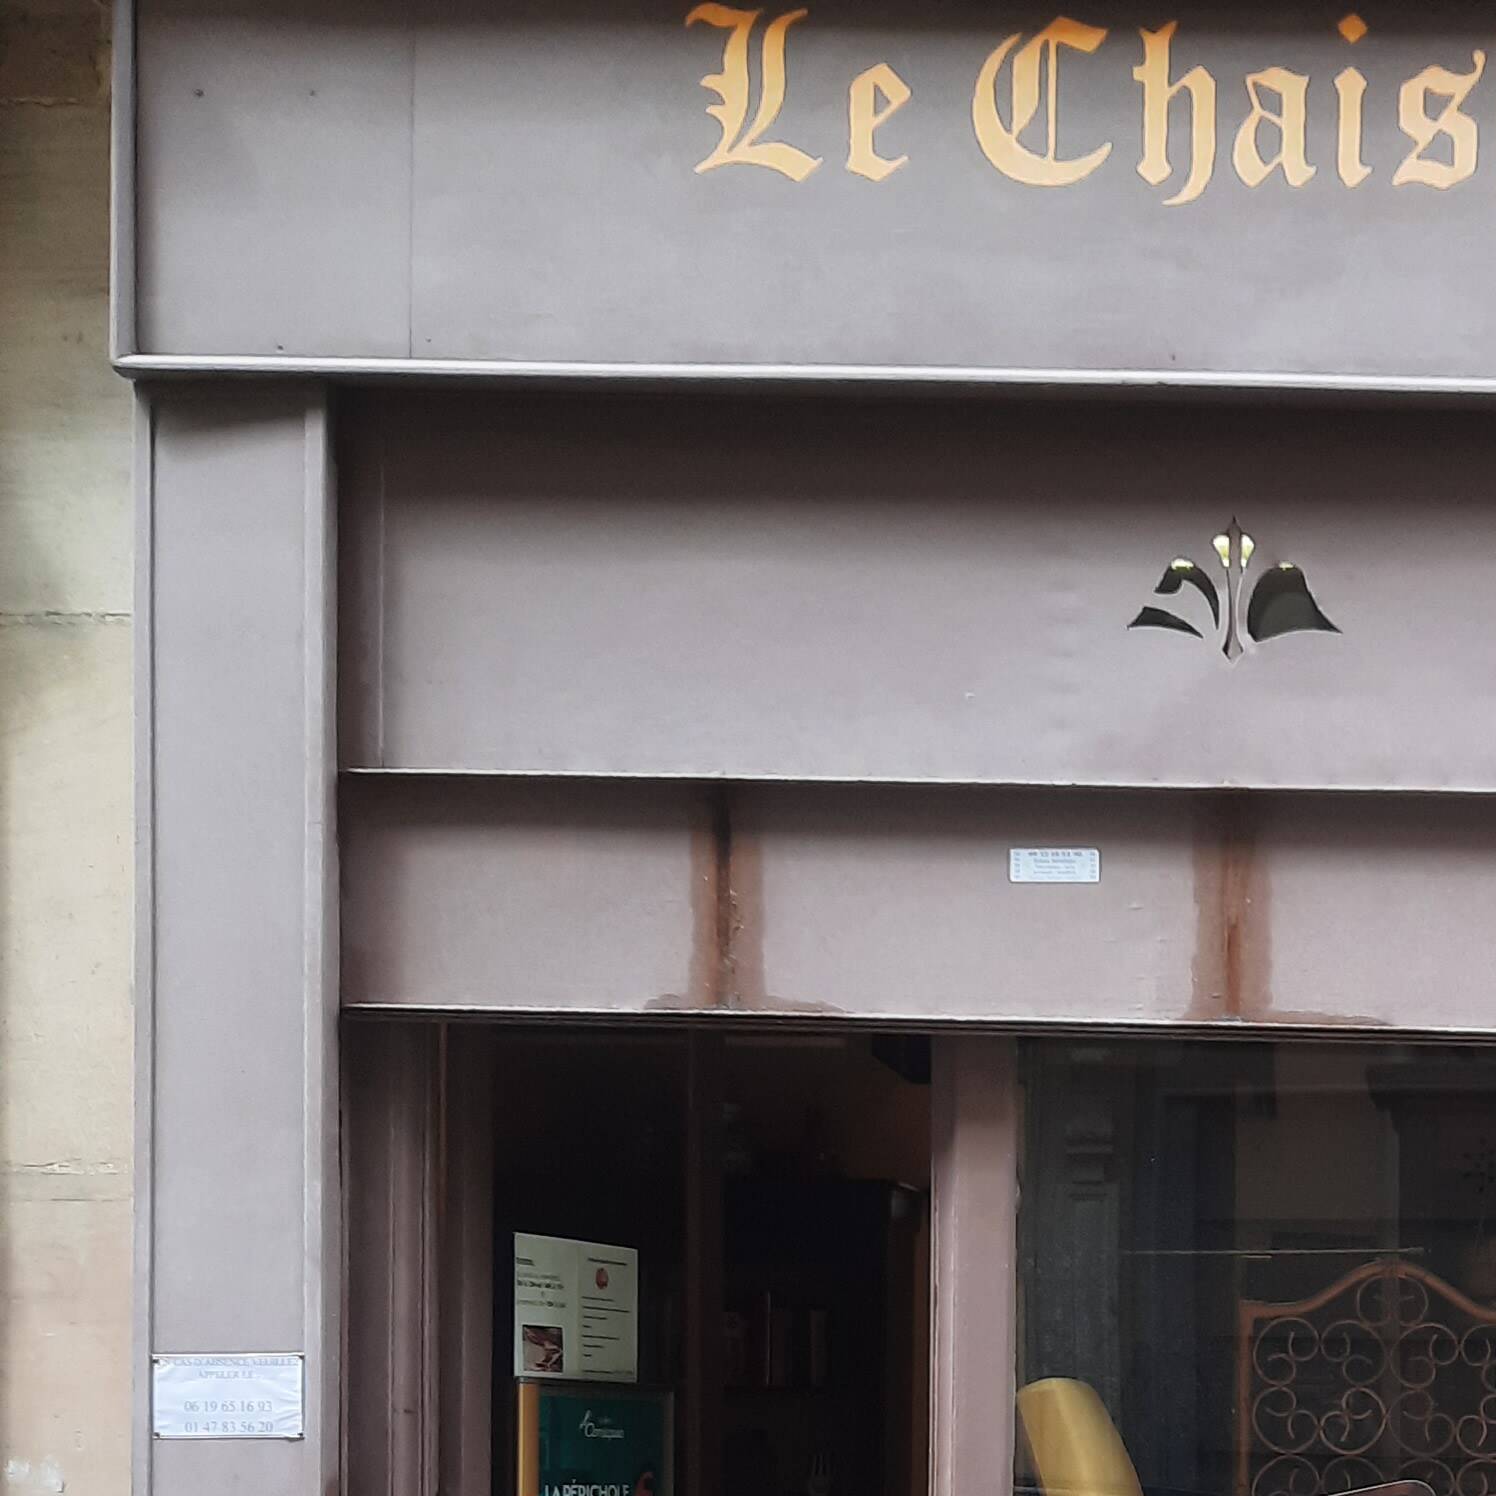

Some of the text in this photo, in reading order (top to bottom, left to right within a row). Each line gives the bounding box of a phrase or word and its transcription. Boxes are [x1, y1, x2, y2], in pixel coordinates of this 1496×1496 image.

[686, 2, 911, 182] Le
[184, 1400, 273, 1412] 06 19 65 16 93
[185, 1421, 274, 1433] 01 47 83 56 20
